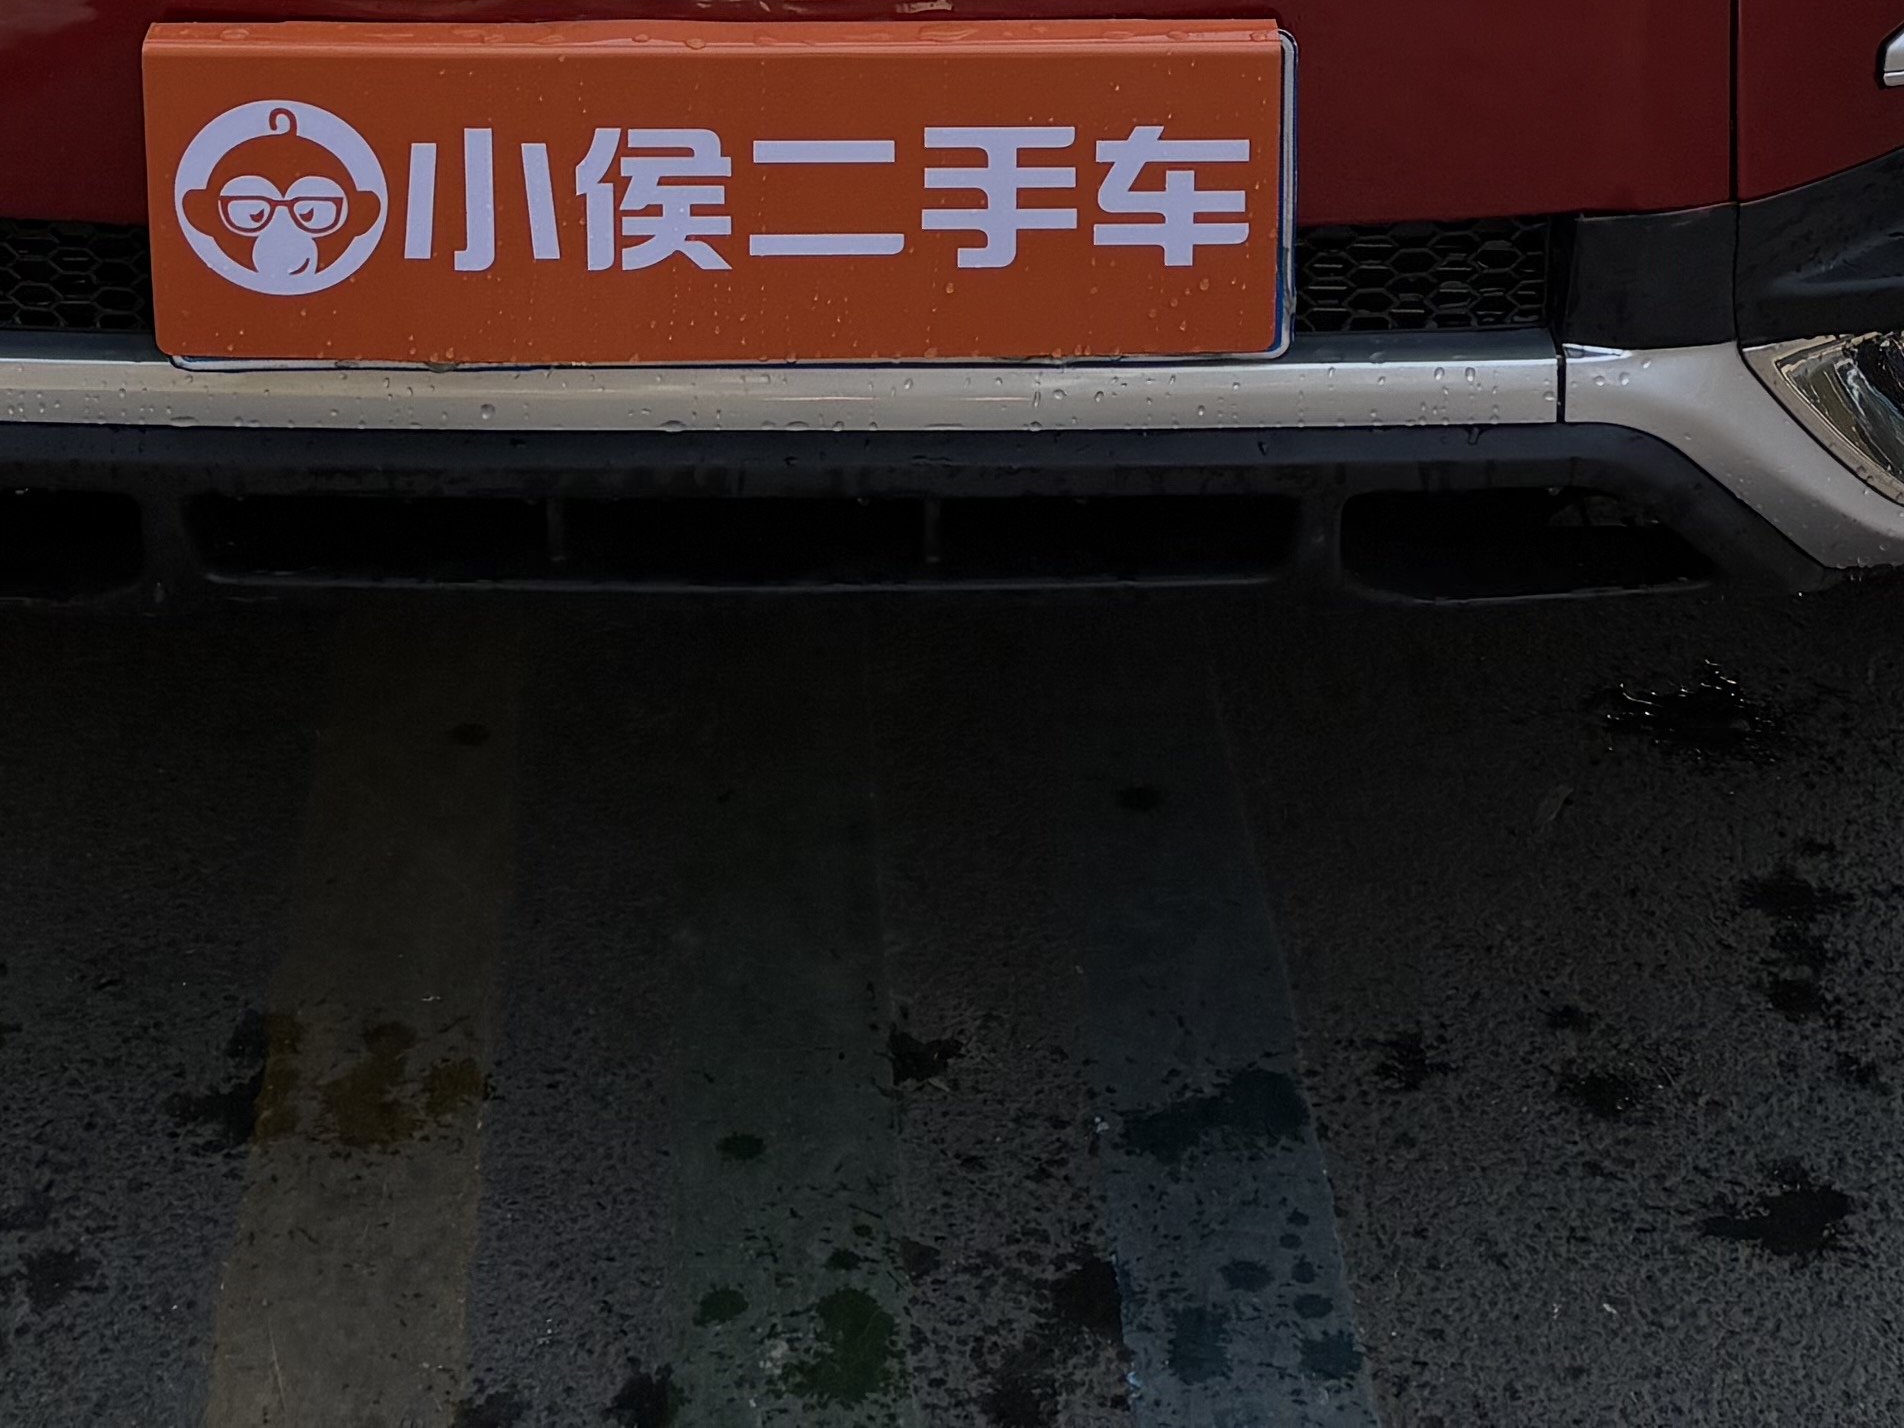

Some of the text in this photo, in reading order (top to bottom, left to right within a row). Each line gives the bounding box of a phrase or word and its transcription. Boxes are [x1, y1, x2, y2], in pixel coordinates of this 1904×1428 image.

[404, 125, 1250, 270] 小侯二手车
